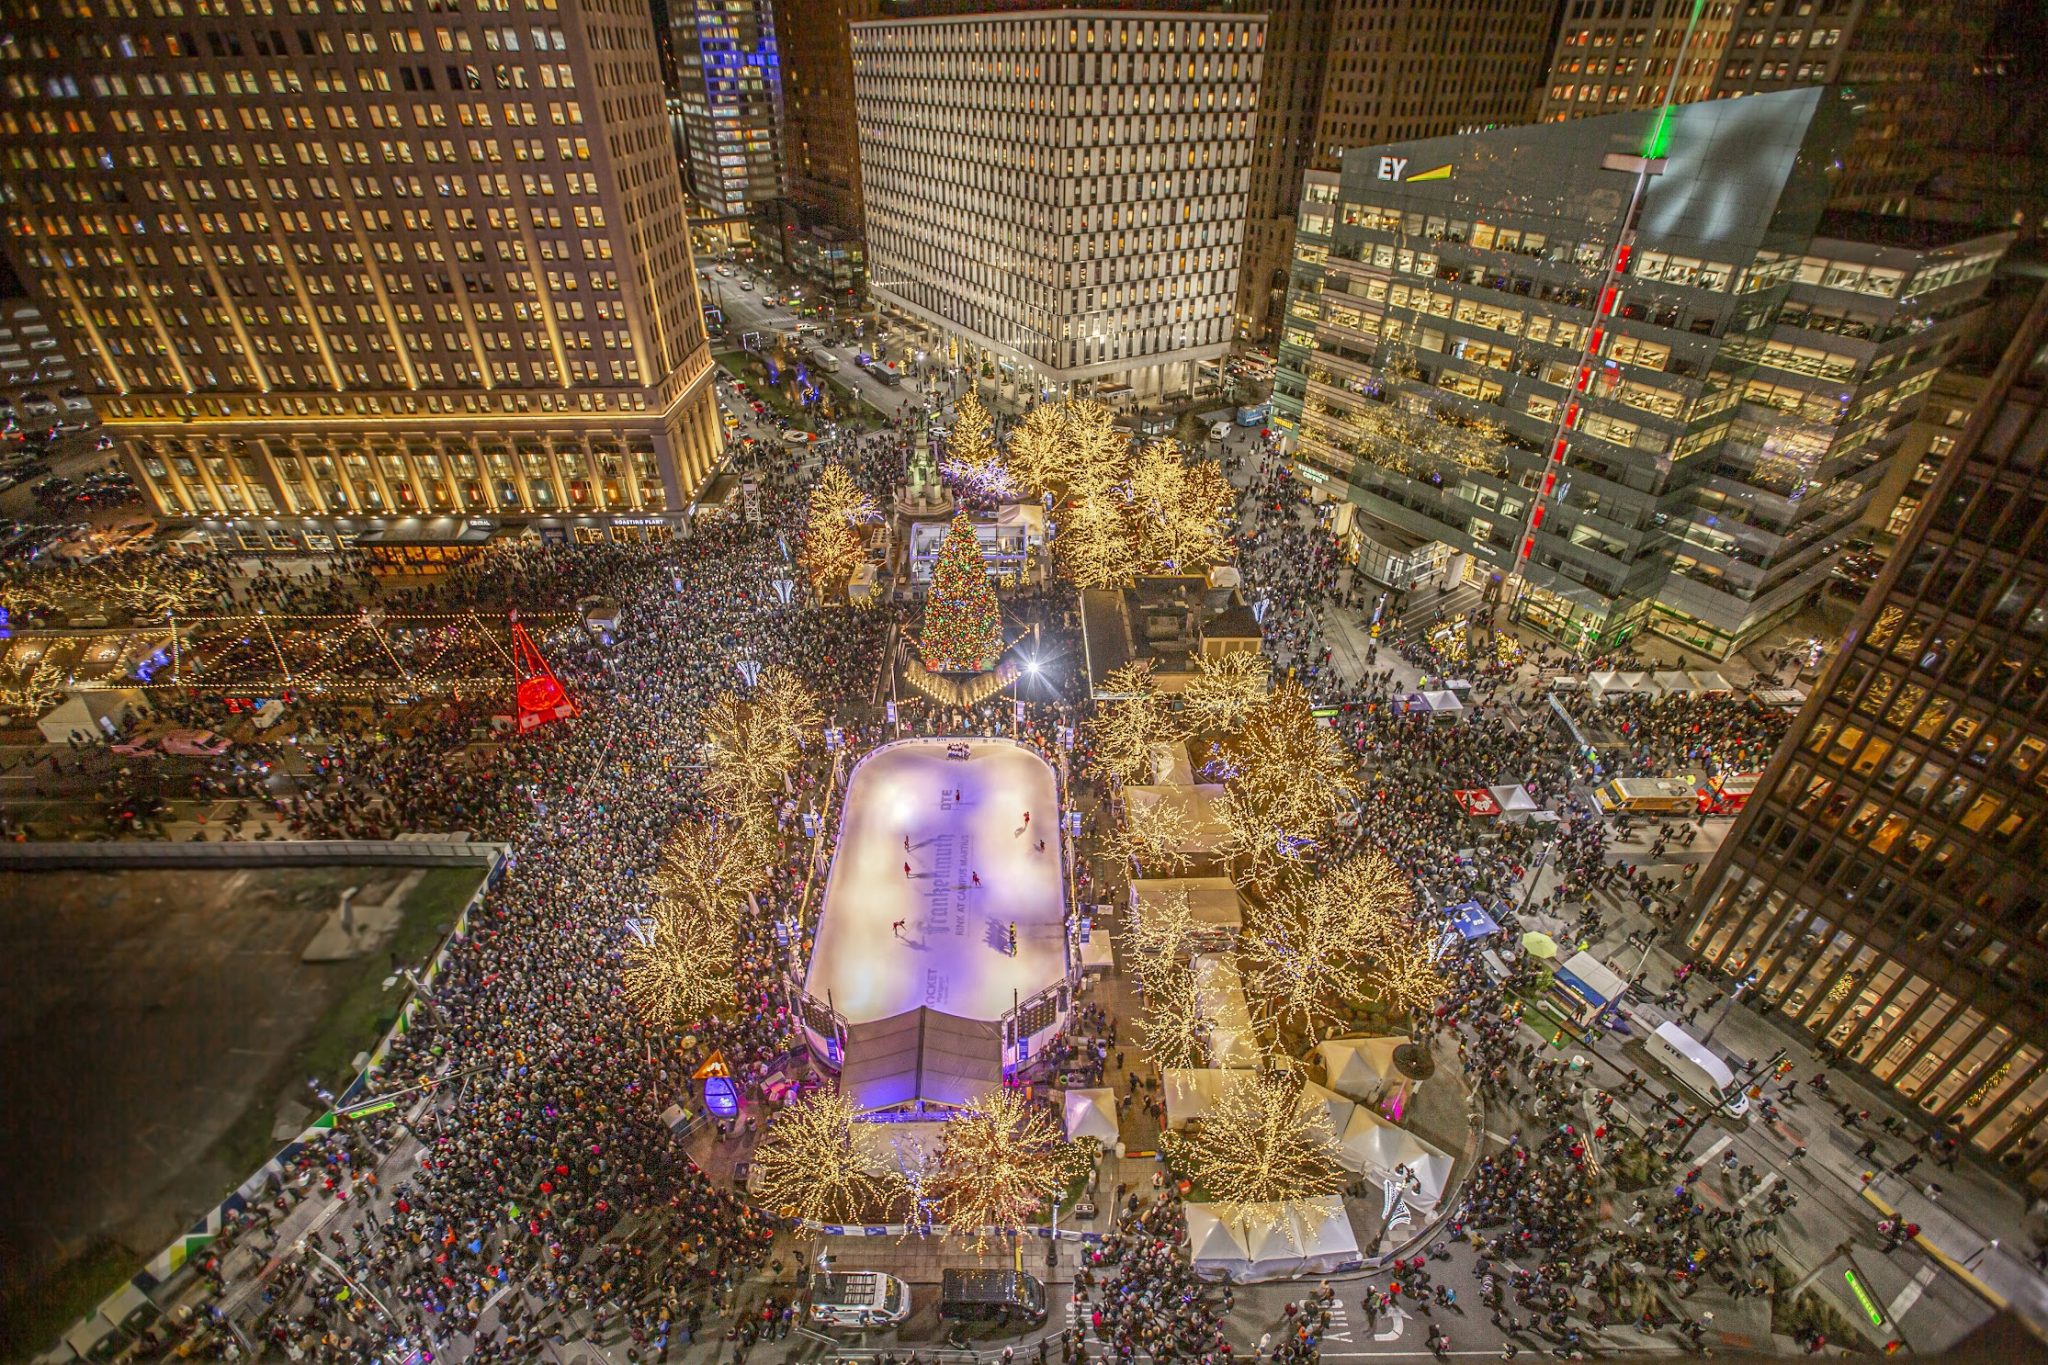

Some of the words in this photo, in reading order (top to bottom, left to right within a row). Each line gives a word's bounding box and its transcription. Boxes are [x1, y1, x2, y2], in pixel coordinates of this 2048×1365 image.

[1378, 156, 1407, 181] EY
[1298, 463, 1329, 481] STARBUCKS
[1303, 471, 1323, 484] COFFEE
[940, 789, 952, 811] DTE
[959, 834, 969, 867] MARTIUS
[917, 833, 955, 935] Frankenmuth
[957, 867, 968, 901] CAMPUS
[956, 902, 965, 914] AT
[955, 915, 965, 936] RINK
[1629, 936, 1646, 952] DTE
[1608, 961, 1622, 976] DTE
[925, 968, 937, 1008] OCKET
[1663, 1043, 1682, 1058] DTE
